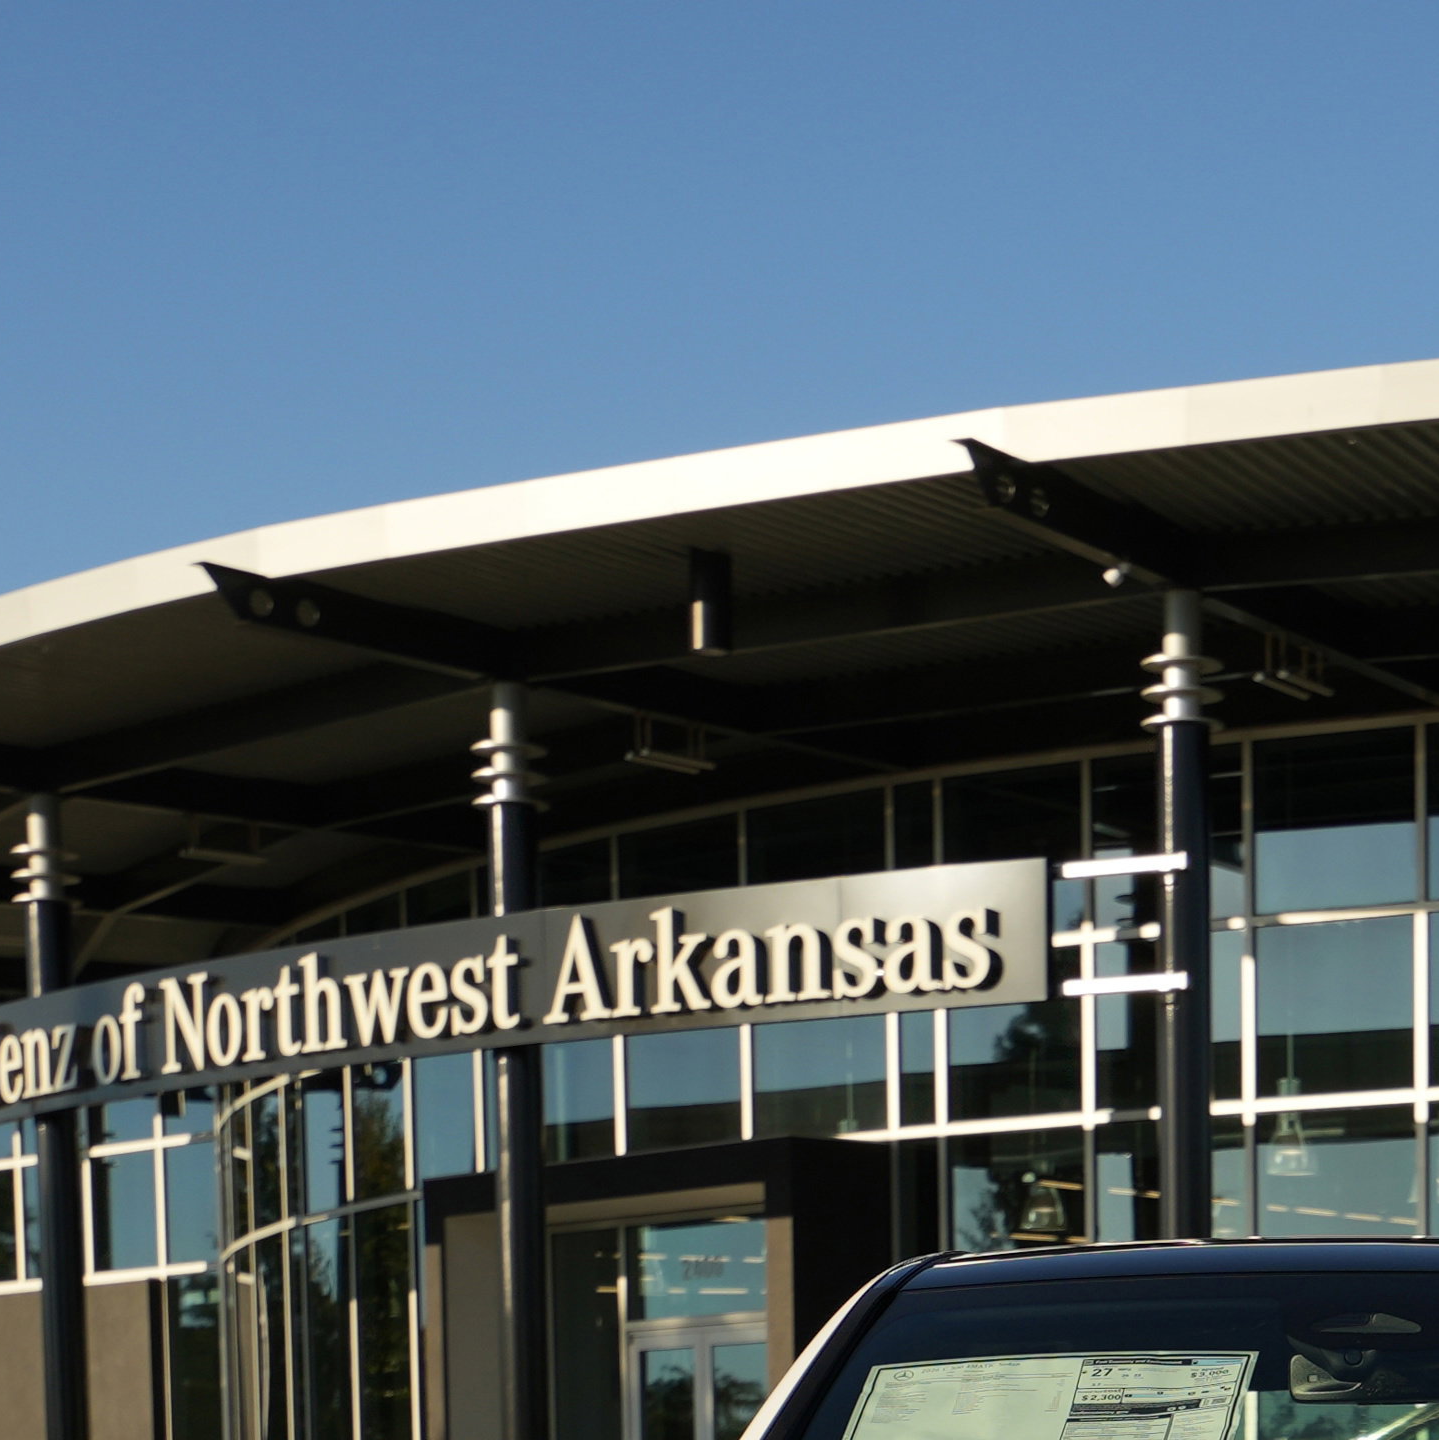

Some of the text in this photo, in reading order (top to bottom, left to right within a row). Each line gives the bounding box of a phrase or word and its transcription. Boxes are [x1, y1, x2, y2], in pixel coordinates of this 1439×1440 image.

[92, 982, 146, 1086] of
[159, 933, 521, 1075] Northwest
[543, 905, 999, 1026] Arkansas
[1091, 1367, 1113, 1377] 27
